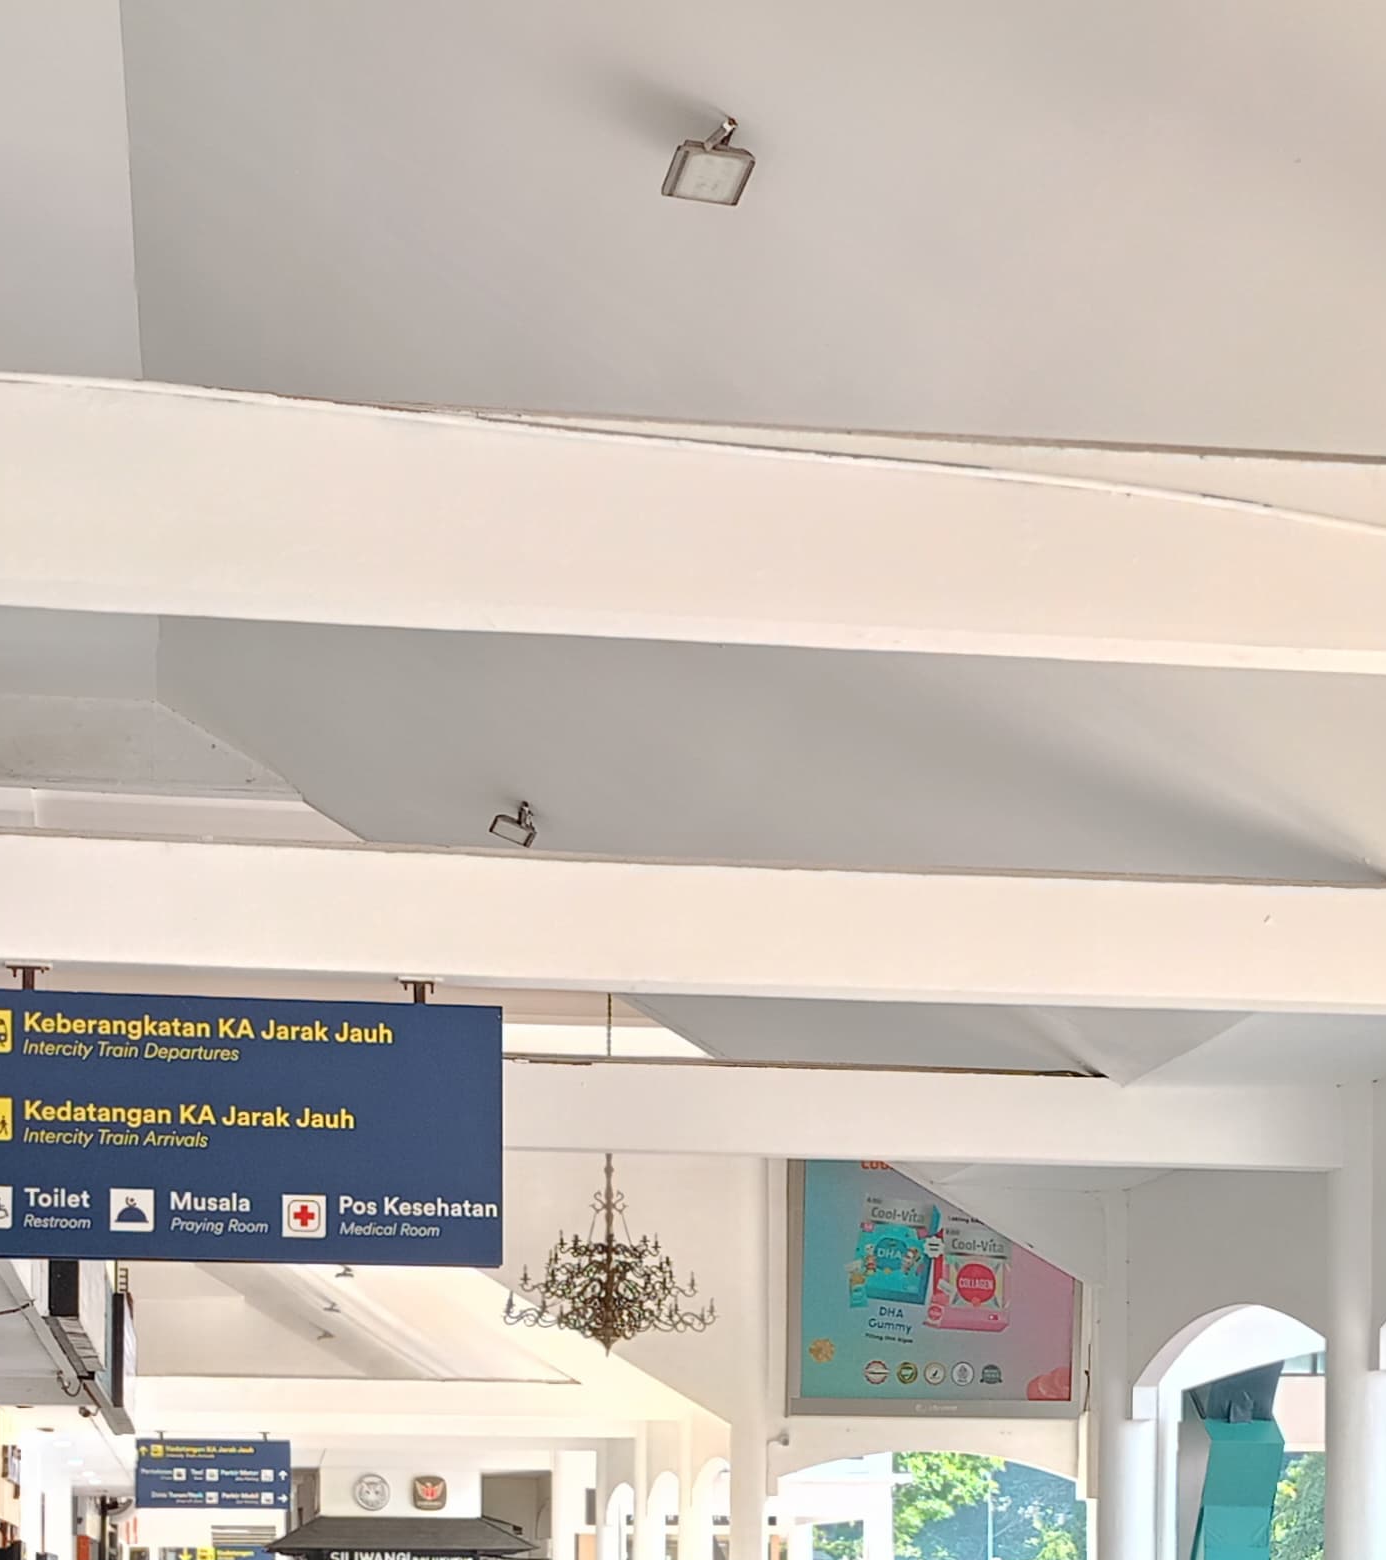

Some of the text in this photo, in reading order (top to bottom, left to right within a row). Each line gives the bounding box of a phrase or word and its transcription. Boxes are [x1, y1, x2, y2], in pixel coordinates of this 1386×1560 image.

[24, 1011, 393, 1044] Keberangkatan KA Jarak Jauh
[23, 1040, 240, 1063] Intercity Train Departures
[24, 1099, 355, 1130] Kedatangan KA Jarak Jauh
[23, 1128, 209, 1148] Intercity Train Arrivals
[23, 1187, 90, 1209] Toilet
[170, 1191, 251, 1212] Musala
[339, 1196, 498, 1218] Pos Kesehatan
[23, 1213, 91, 1229] Restroom
[870, 1206, 925, 1224] Cool-Vita
[170, 1217, 269, 1236] Praying Room
[339, 1220, 441, 1237] Medical Room
[877, 1247, 903, 1260] DHA
[951, 1238, 1005, 1253] Cool-Vita
[879, 1306, 904, 1318] DHA
[868, 1318, 912, 1335] Gummy
